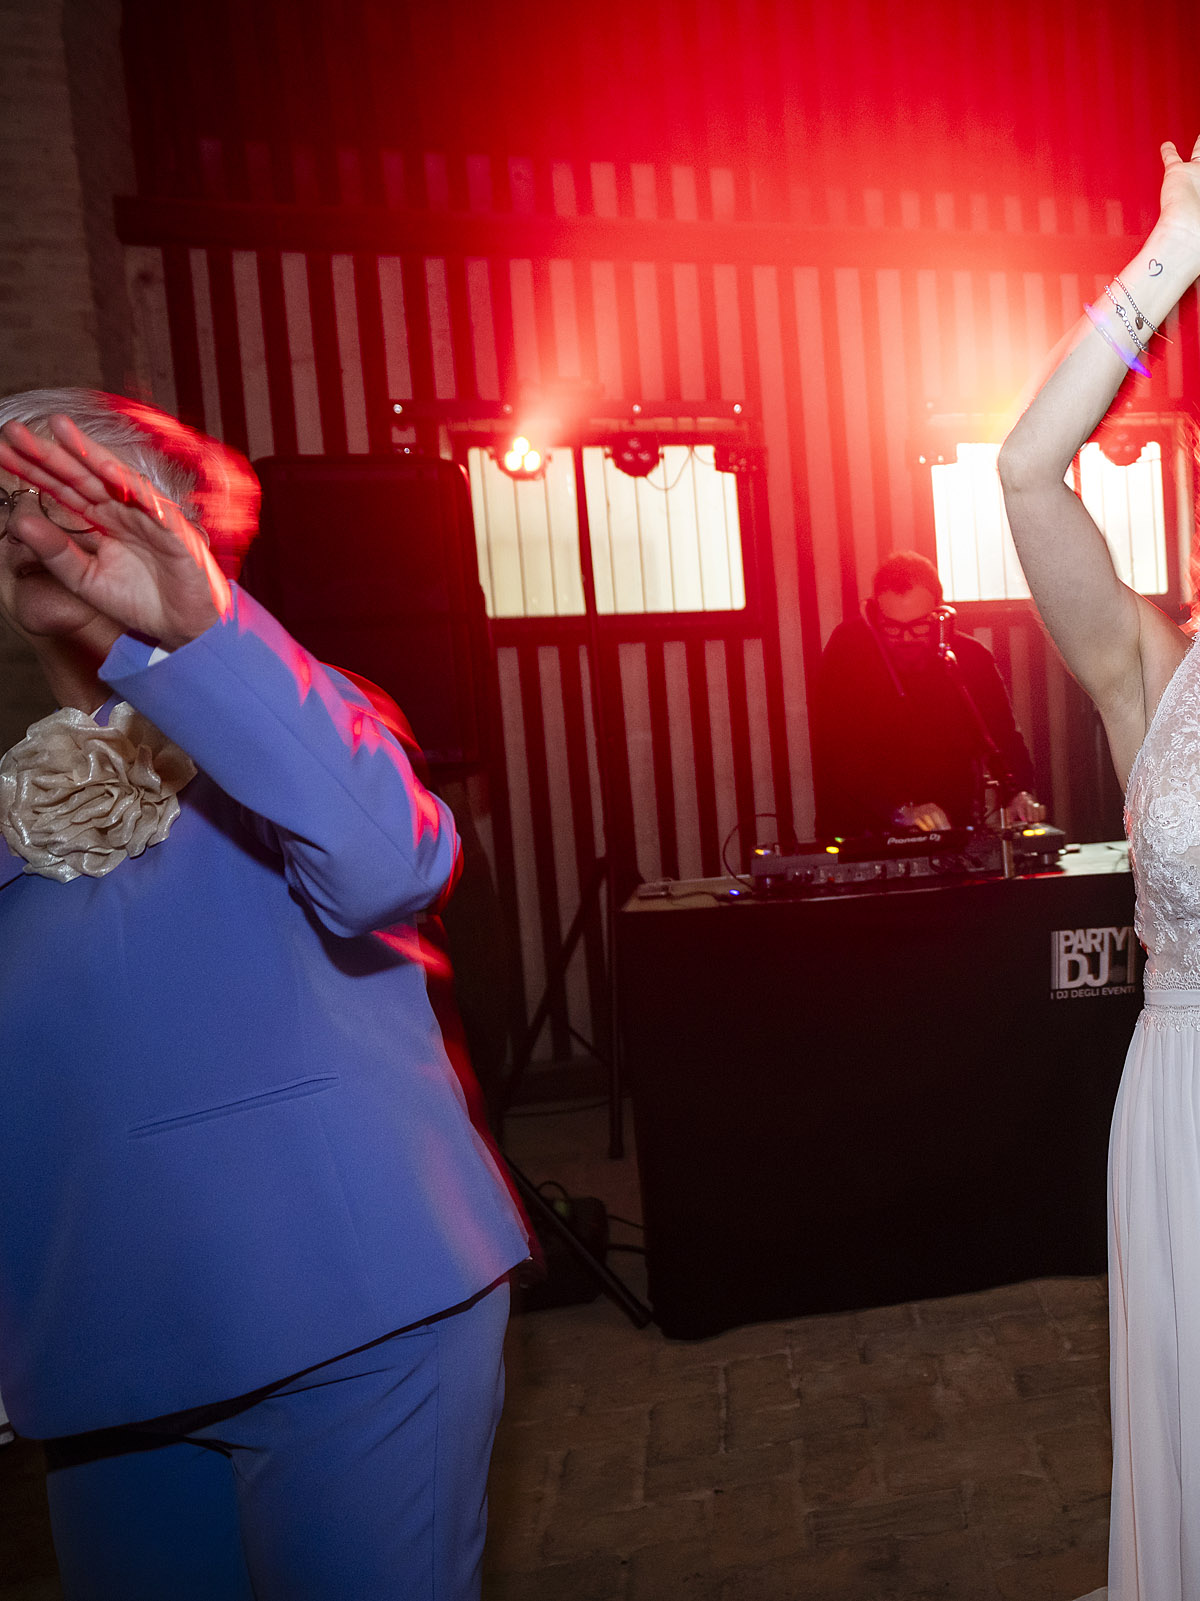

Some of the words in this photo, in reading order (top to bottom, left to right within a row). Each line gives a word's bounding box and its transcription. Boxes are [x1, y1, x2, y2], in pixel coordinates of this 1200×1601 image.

[1059, 927, 1129, 954] PARTY
[1059, 951, 1109, 989] DJ
[1056, 990, 1069, 1000] DJ
[1071, 988, 1100, 998] DEGLI
